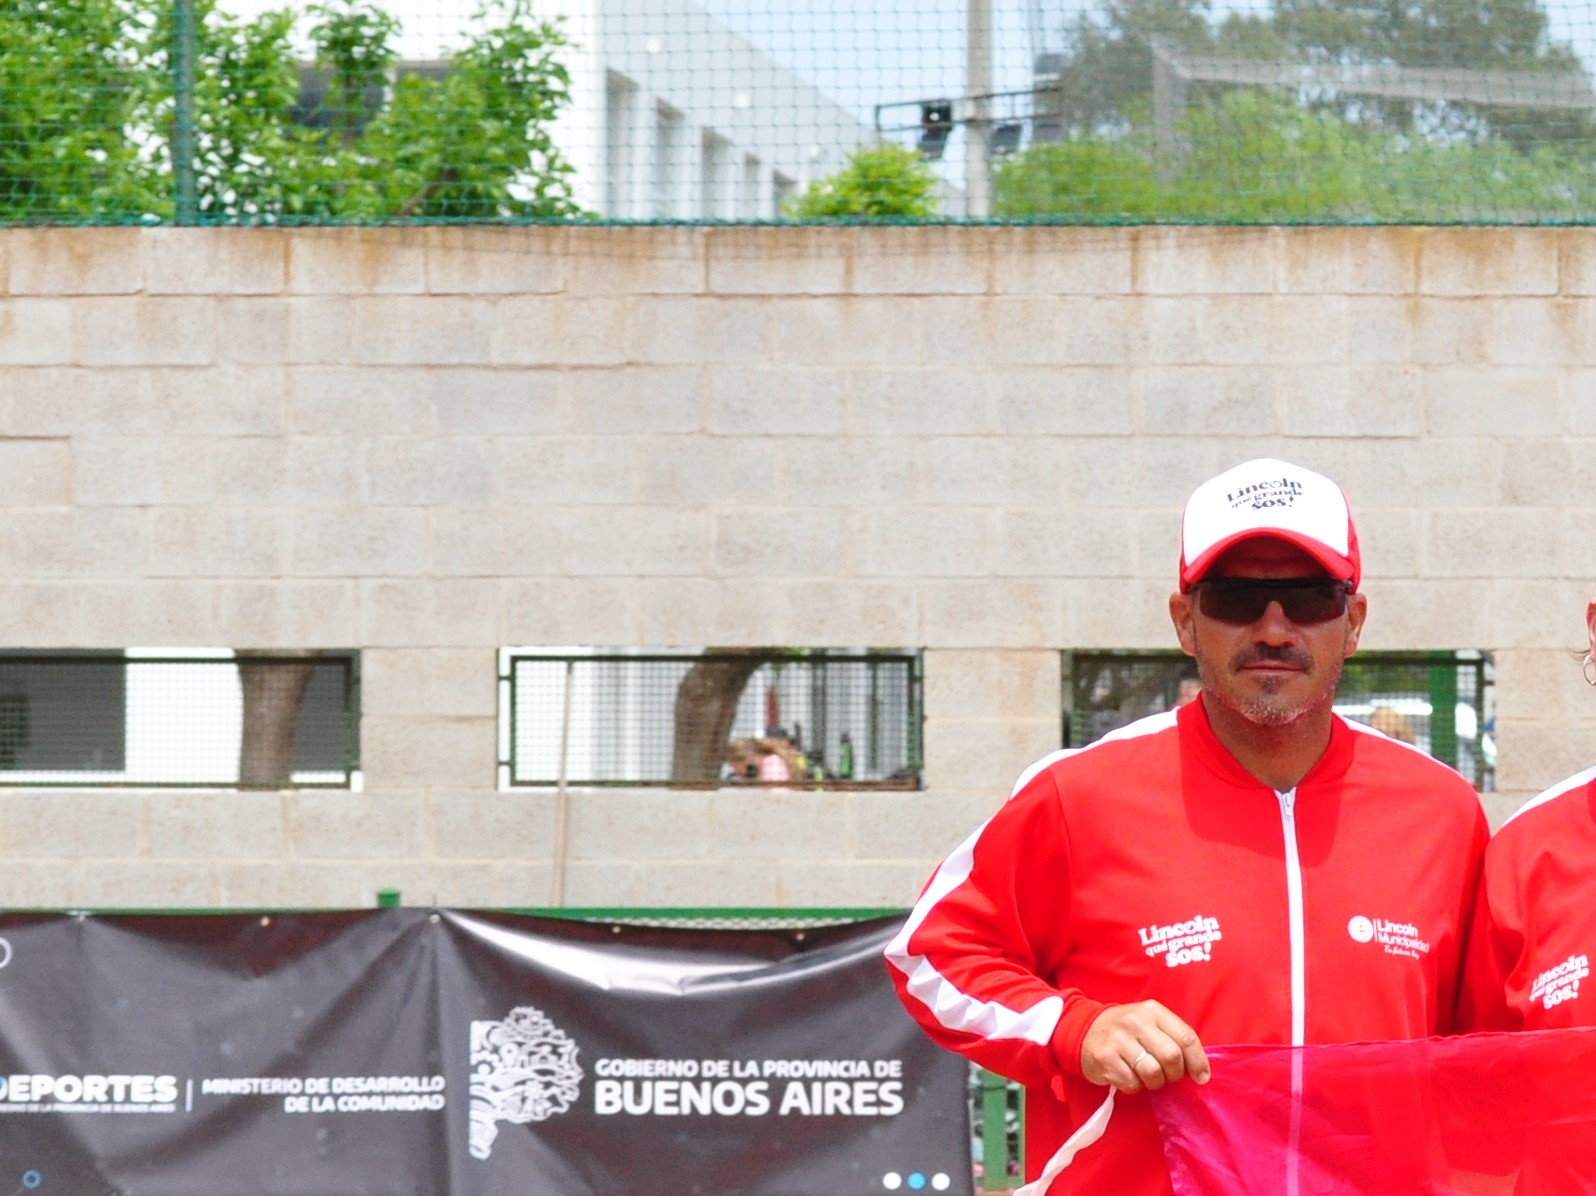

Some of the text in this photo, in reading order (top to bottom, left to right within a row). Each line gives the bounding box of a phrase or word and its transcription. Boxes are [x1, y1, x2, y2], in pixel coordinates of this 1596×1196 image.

[1227, 477, 1303, 503] Lincoln
[1137, 914, 1220, 947] Lincoln
[1531, 954, 1589, 994] Lincoln
[594, 1058, 903, 1077] GOBIERNO DE LA PROVINCIA DE
[202, 1075, 446, 1095] MINISTERIO DE DESARROLLO
[594, 1079, 904, 1116] BUENOS AIRES
[284, 1094, 445, 1113] DE LA COMUNIDAD
